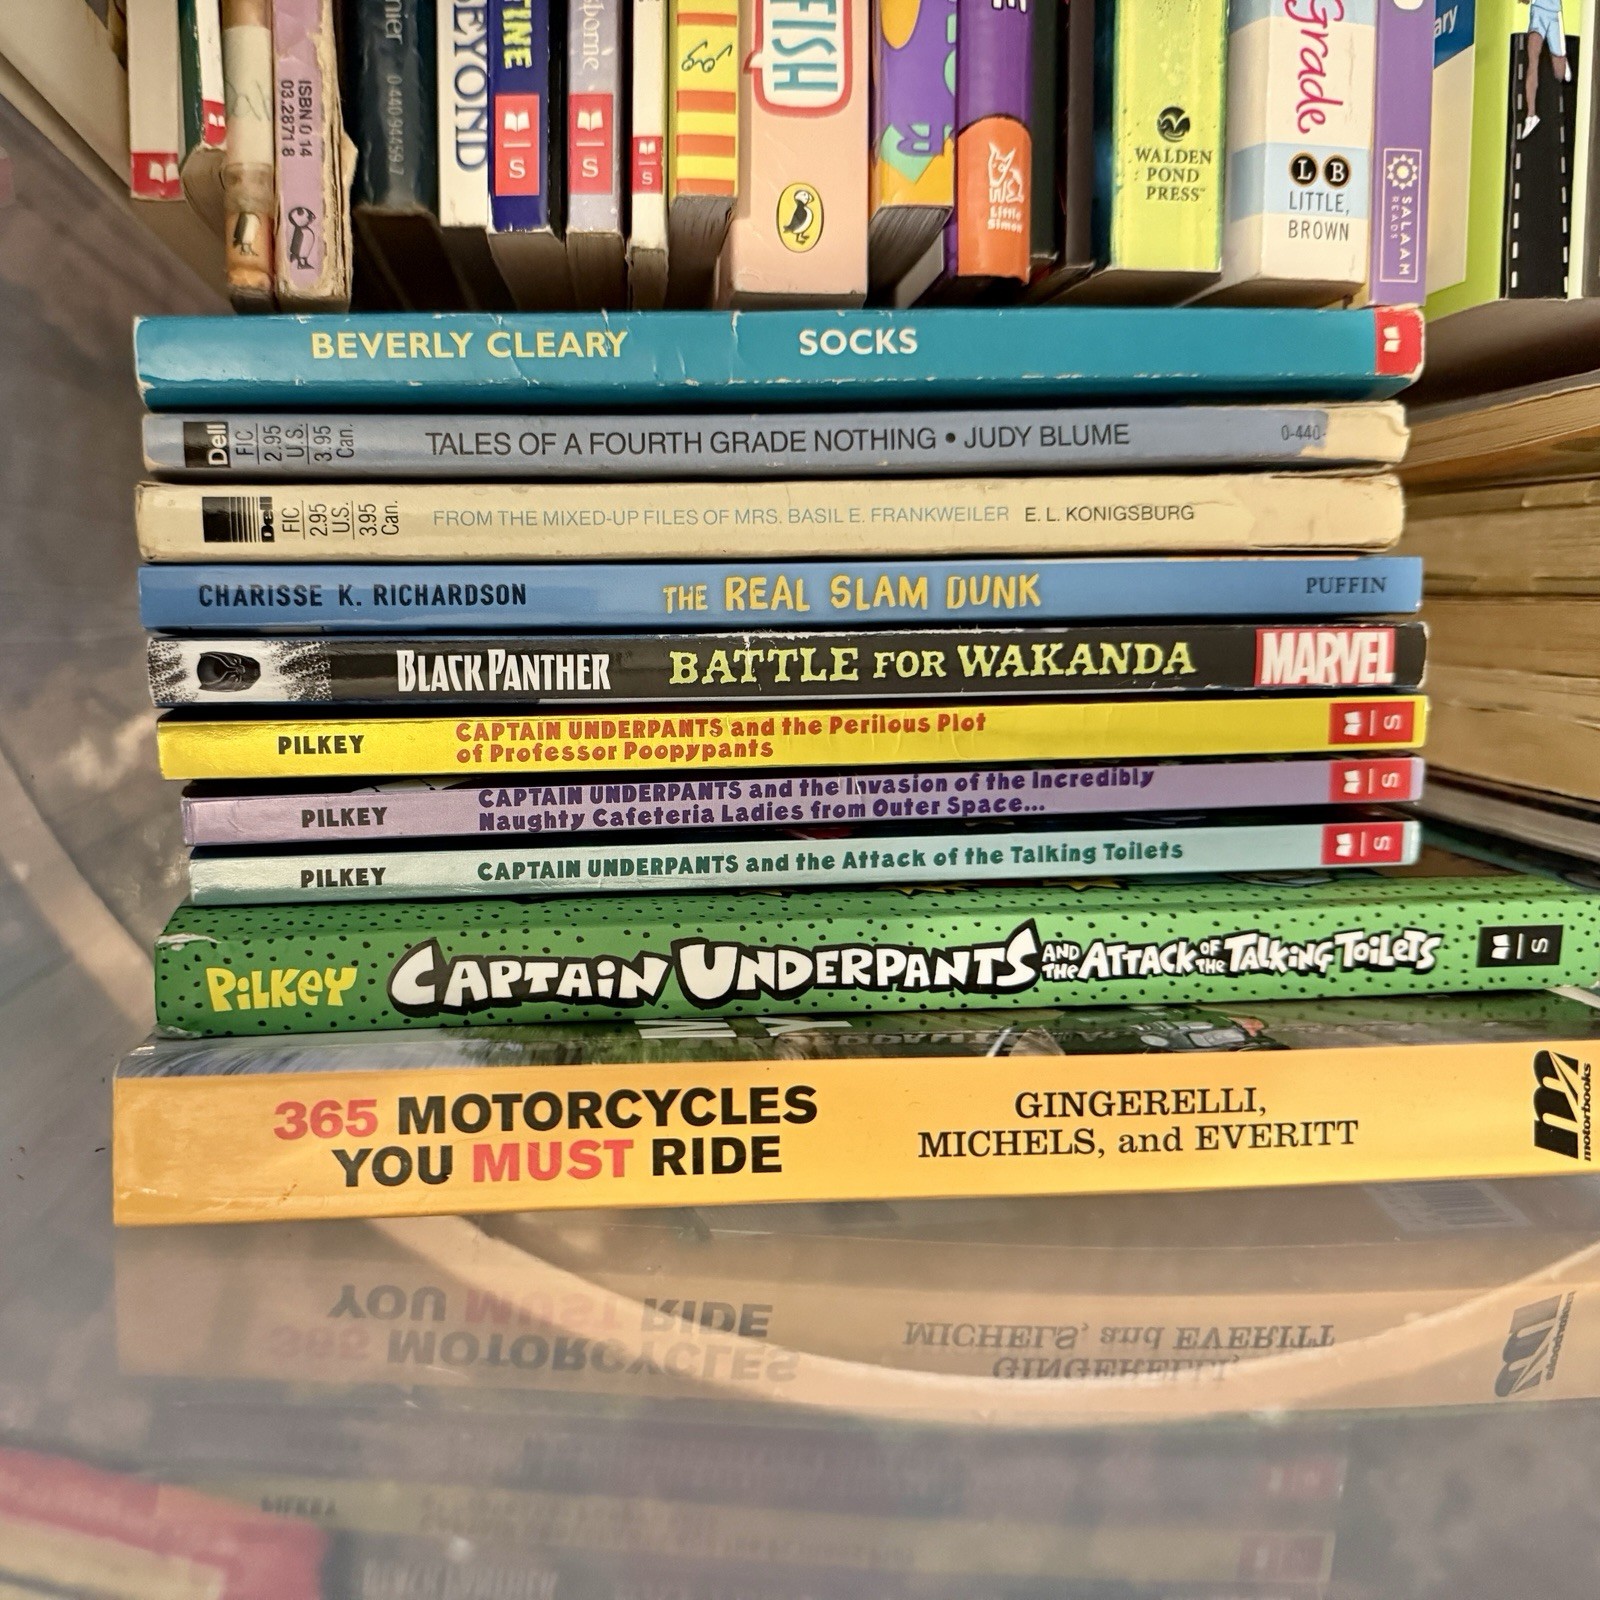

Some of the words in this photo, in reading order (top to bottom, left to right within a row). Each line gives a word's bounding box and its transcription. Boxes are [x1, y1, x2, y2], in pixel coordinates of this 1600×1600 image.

[1434, 5, 1458, 38] ary
[772, 0, 838, 92] FISH
[1284, 0, 1344, 134] Grade
[299, 80, 312, 120] ISBN
[454, 0, 487, 172] EYOND
[300, 140, 312, 157] 14
[1136, 147, 1214, 163] WALDEN
[509, 158, 526, 179] S
[582, 157, 599, 178] S
[642, 172, 653, 185] S
[1147, 167, 1199, 182] POND
[1298, 160, 1312, 181] L
[1330, 162, 1345, 182] B
[989, 206, 1021, 221] Little
[1289, 192, 1350, 215] LITTLE,
[1390, 196, 1399, 239] READS
[988, 218, 1022, 233] Simon
[1288, 220, 1349, 241] BROWN
[1399, 196, 1412, 275] SALAAM
[312, 332, 474, 359] BEVERLY
[487, 331, 628, 358] CLEARY
[799, 328, 919, 356] SOCKS
[207, 424, 228, 465] Dell
[235, 430, 254, 455] FIC
[263, 425, 283, 461] 2.95
[286, 424, 304, 457] U.S.
[313, 425, 332, 461] 3.95
[337, 424, 354, 458] Can.
[424, 431, 511, 455] TALES
[519, 431, 560, 454] OF
[563, 431, 583, 453] A
[590, 430, 702, 453] FOURTH
[710, 429, 807, 453] GRADE
[814, 428, 936, 451] NOTHING
[964, 426, 1032, 449] JUDY
[1040, 424, 1130, 446] BLUME
[282, 507, 300, 532] FIC
[309, 503, 328, 536] 2.95
[332, 502, 350, 532] U.S.
[359, 503, 378, 536] 3.95
[382, 501, 399, 535] Can.
[434, 510, 493, 527] FROM
[498, 510, 537, 526] THE
[542, 509, 639, 526] MIXED-UP
[644, 509, 699, 525] FILES
[703, 509, 730, 525] OF
[734, 508, 782, 525] MRS.
[788, 507, 845, 524] BASIL
[850, 507, 865, 523] E.
[871, 506, 1010, 523] FRANKWEILER
[1025, 506, 1041, 522] E.
[1045, 506, 1060, 521] L.
[1066, 504, 1194, 522] KONIGSBURG
[199, 584, 323, 607] CHARISSE
[339, 584, 361, 606] K.
[373, 583, 527, 606] RICHARDSON
[663, 584, 708, 614] THE
[725, 574, 810, 612] REAL
[830, 574, 929, 611] SLAM
[947, 573, 1041, 610] DUNK
[1306, 576, 1387, 594] PUFFIN
[397, 649, 484, 691] BLACK
[487, 649, 611, 691] PANTHER
[669, 647, 859, 685] BATTLE
[873, 648, 947, 679] FOR
[957, 641, 1197, 677] WAKANDA
[1261, 630, 1396, 686] MARVEL
[456, 721, 561, 742] CAPTAIN
[568, 718, 723, 740] UNDERPANTS
[730, 715, 775, 736] and
[781, 715, 822, 735] the
[830, 713, 929, 735] Perilous
[937, 712, 986, 732] Plot
[1385, 714, 1401, 729] S
[278, 734, 365, 755] PILKEY
[456, 743, 483, 763] of
[490, 742, 617, 763] Professor
[624, 739, 773, 763] Poopypants
[479, 787, 582, 808] CAPTAIN
[590, 781, 741, 805] UNDERPANTS
[749, 779, 794, 799] and
[799, 778, 840, 798] the
[846, 774, 948, 796] Invasion
[954, 772, 980, 792] of
[986, 771, 1025, 791] the
[1032, 767, 1154, 790] Incredibly
[1382, 772, 1398, 787] S
[301, 807, 387, 829] PILKEY
[479, 811, 586, 833] Naughty
[592, 804, 715, 829] Cafeteria
[721, 801, 804, 823] Ladies
[811, 799, 866, 819] from
[872, 796, 941, 817] Outer
[947, 795, 1045, 817] Space...
[1374, 835, 1391, 851] S
[478, 860, 581, 882] CAPTAIN
[587, 854, 738, 880] UNDERPANTS
[745, 852, 791, 873] and
[796, 851, 836, 870] the
[842, 847, 926, 869] Attack
[933, 846, 959, 866] of
[963, 844, 1004, 865] the
[1011, 843, 1098, 865] Talking
[1104, 840, 1184, 861] Toilets
[300, 867, 387, 888] PILKEY
[1042, 943, 1080, 962] AND
[1077, 941, 1198, 979] ATTACK
[1200, 939, 1222, 956] OF
[1532, 937, 1549, 953] S
[680, 924, 1037, 1000] UNDERPANTS
[273, 1100, 378, 1140] 365
[398, 1085, 818, 1135] MOTORCYCLES
[1015, 1087, 1266, 1119] GINGERELLI,
[1581, 1062, 1591, 1161] motorbooks
[918, 1128, 1106, 1159] MICHELS,
[1118, 1126, 1182, 1153] and
[1195, 1120, 1359, 1150] EVERITT
[332, 1145, 453, 1187] YOU
[472, 1139, 634, 1182] MUST
[651, 1135, 782, 1176] RIDE
